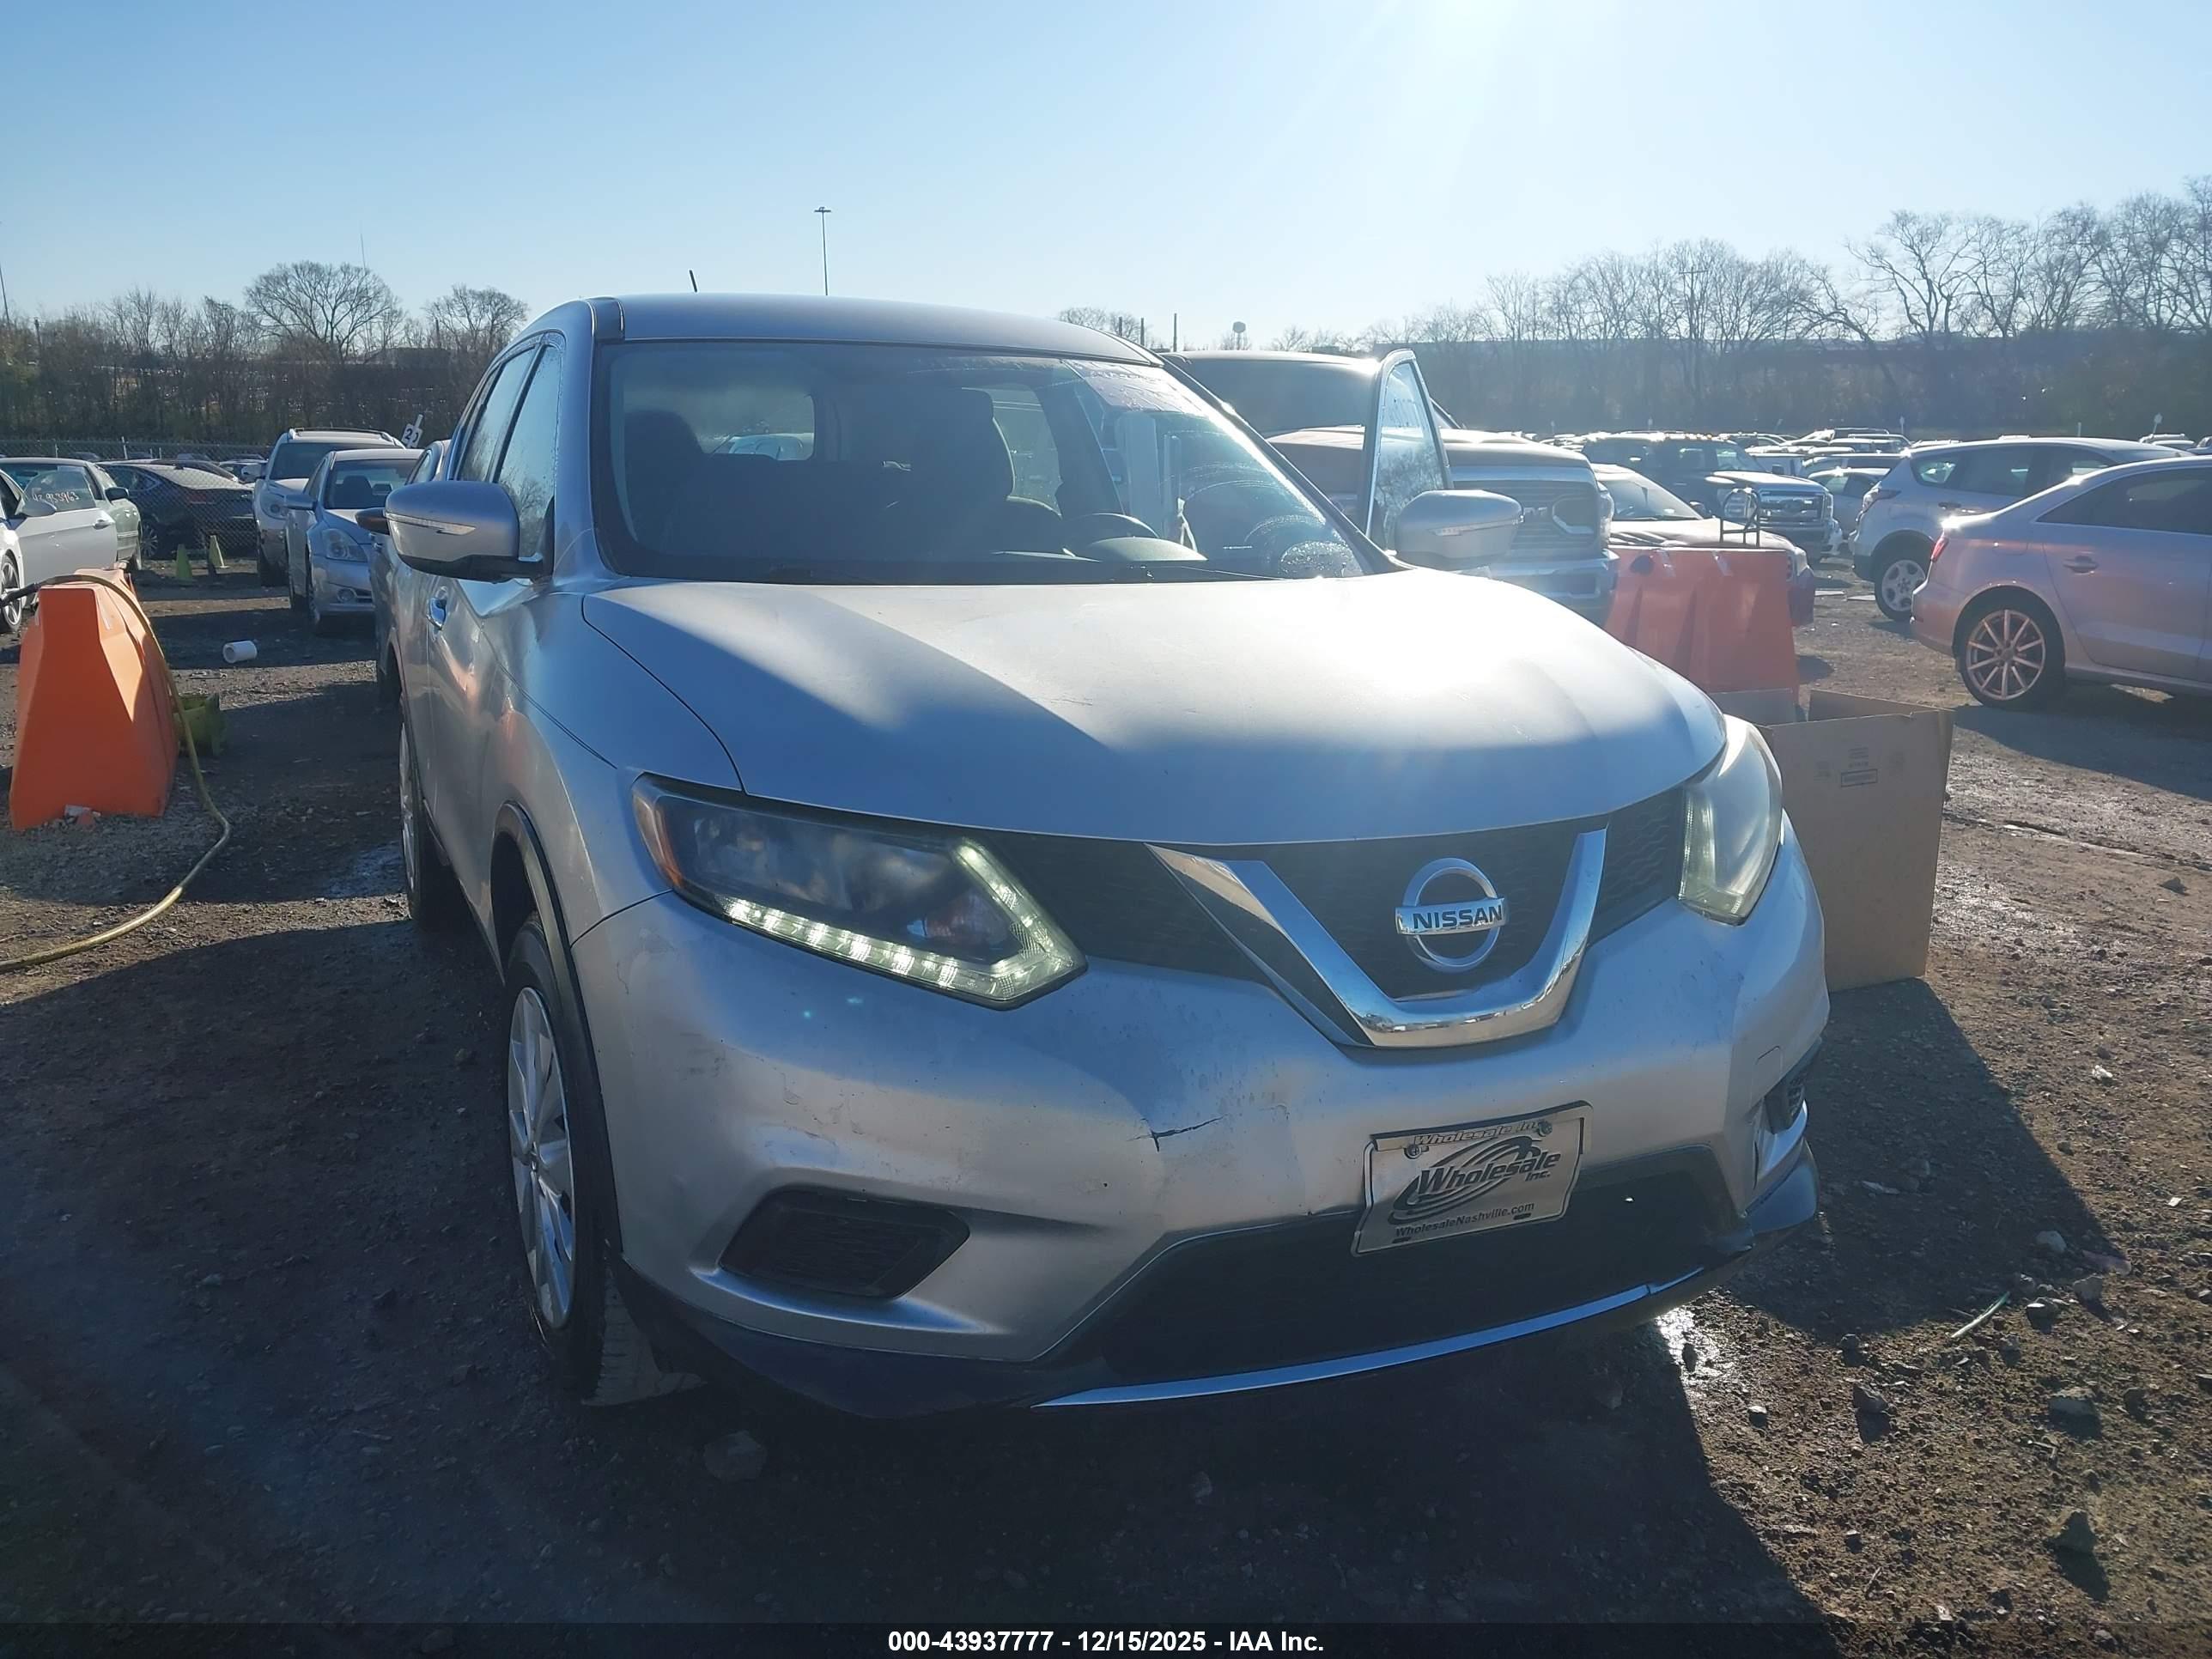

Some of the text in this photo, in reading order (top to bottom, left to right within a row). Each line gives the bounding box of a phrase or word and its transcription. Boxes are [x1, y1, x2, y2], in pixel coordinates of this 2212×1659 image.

[1413, 904, 1502, 929] NISSAN
[1415, 1123, 1513, 1146] Wholesale
[1418, 1153, 1560, 1194] Wholesale
[1525, 1170, 1552, 1182] Inc.
[1395, 1202, 1534, 1237] WholesaleNashville.com
